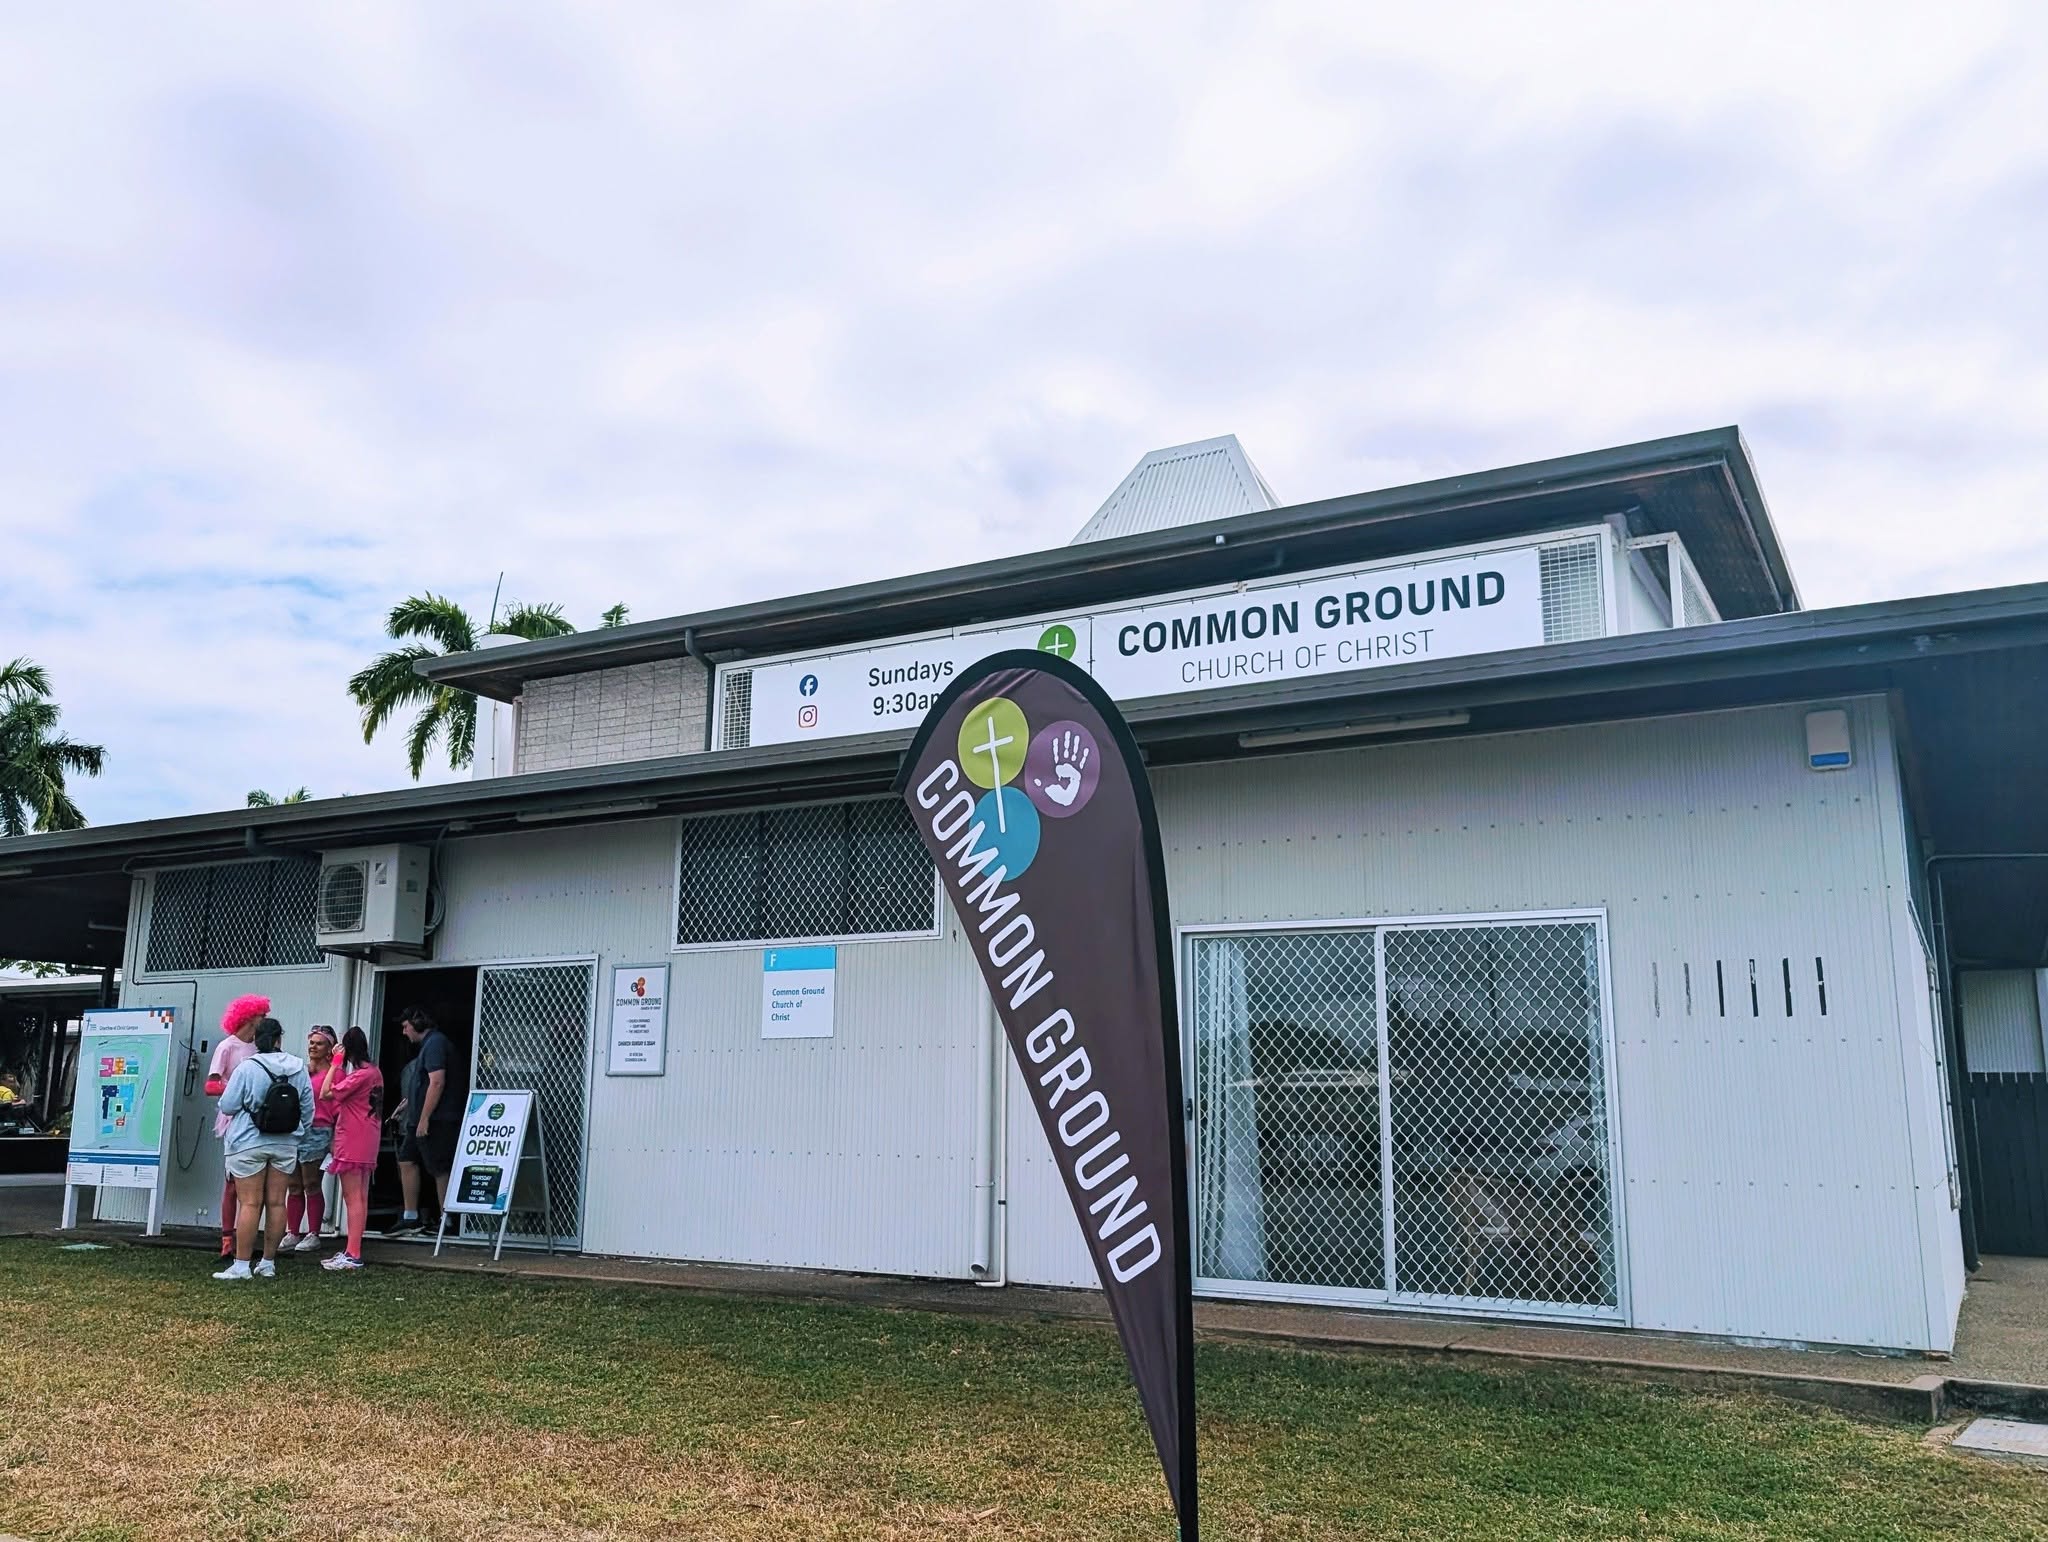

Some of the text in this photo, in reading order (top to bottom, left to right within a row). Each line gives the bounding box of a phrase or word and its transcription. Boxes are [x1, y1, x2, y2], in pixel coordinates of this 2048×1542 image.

[1118, 571, 1505, 657] COMMON GROUND
[1182, 629, 1434, 684] CHURCH OF CHRIST
[868, 660, 954, 688] Sundays
[770, 953, 777, 967] F
[772, 986, 825, 996] Common Ground
[616, 997, 662, 1007] COMMON GROUND
[771, 1000, 803, 1009] Church of
[771, 1013, 790, 1022] Christ
[916, 758, 1162, 1285] COMMON GROUND
[469, 1125, 516, 1138] OPSHOP
[466, 1140, 511, 1157] OPEN!
